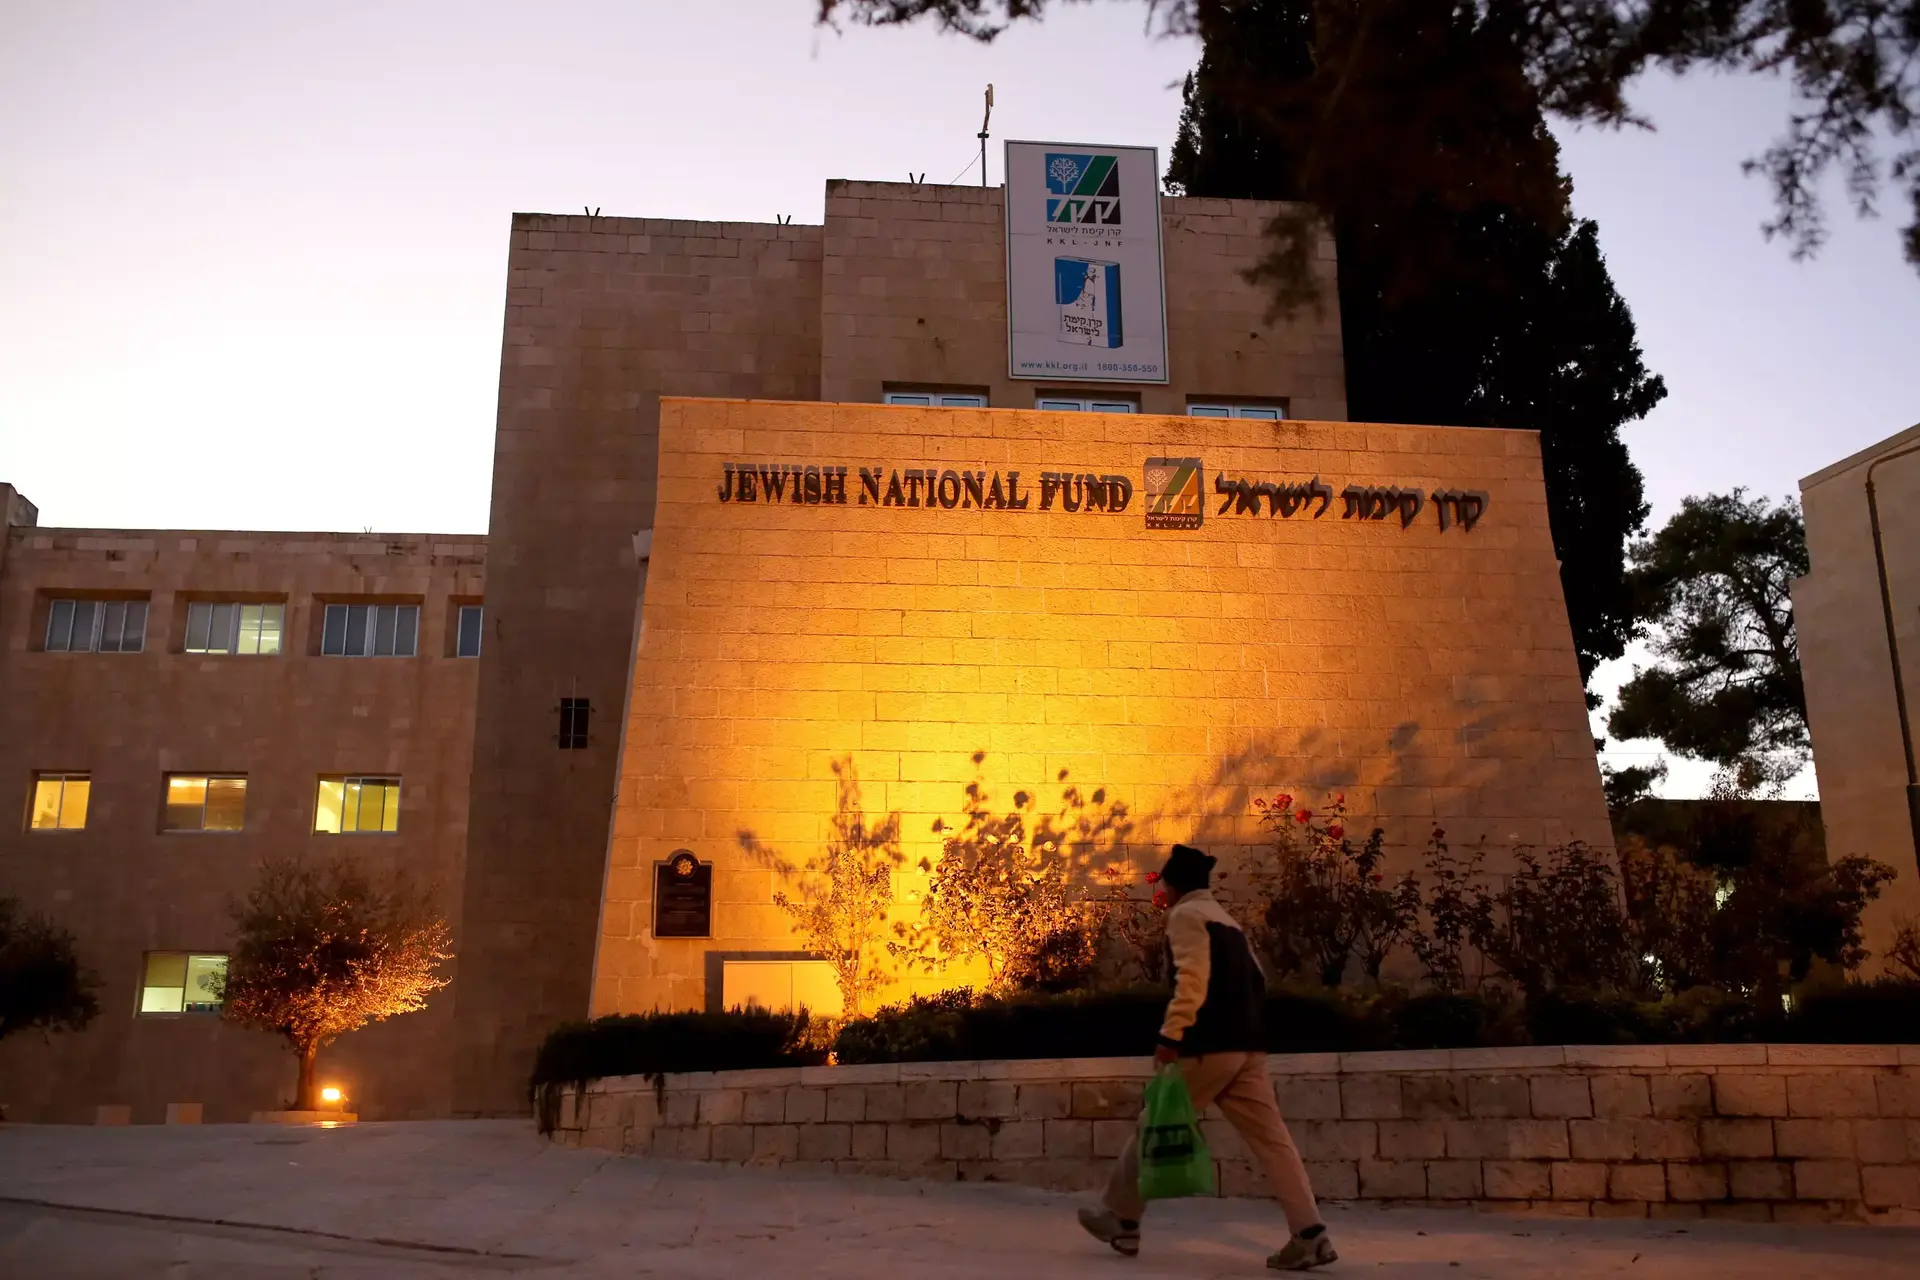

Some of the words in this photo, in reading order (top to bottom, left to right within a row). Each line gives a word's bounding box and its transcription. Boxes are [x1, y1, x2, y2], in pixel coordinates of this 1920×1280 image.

[1046, 224, 1079, 234] לישראל
[1082, 227, 1105, 236] קימת
[1107, 228, 1122, 237] קרן
[1065, 323, 1100, 336] לישראל
[1020, 360, 1088, 371] www.kkl.org.il
[1097, 362, 1158, 373] 1800-350-550
[717, 463, 848, 504] JEWISH
[857, 467, 1029, 510] NATIONAL
[1038, 471, 1133, 513] FUND
[1214, 471, 1333, 520] לישראל
[1341, 484, 1425, 531] קימת
[1430, 487, 1489, 534] קרן
